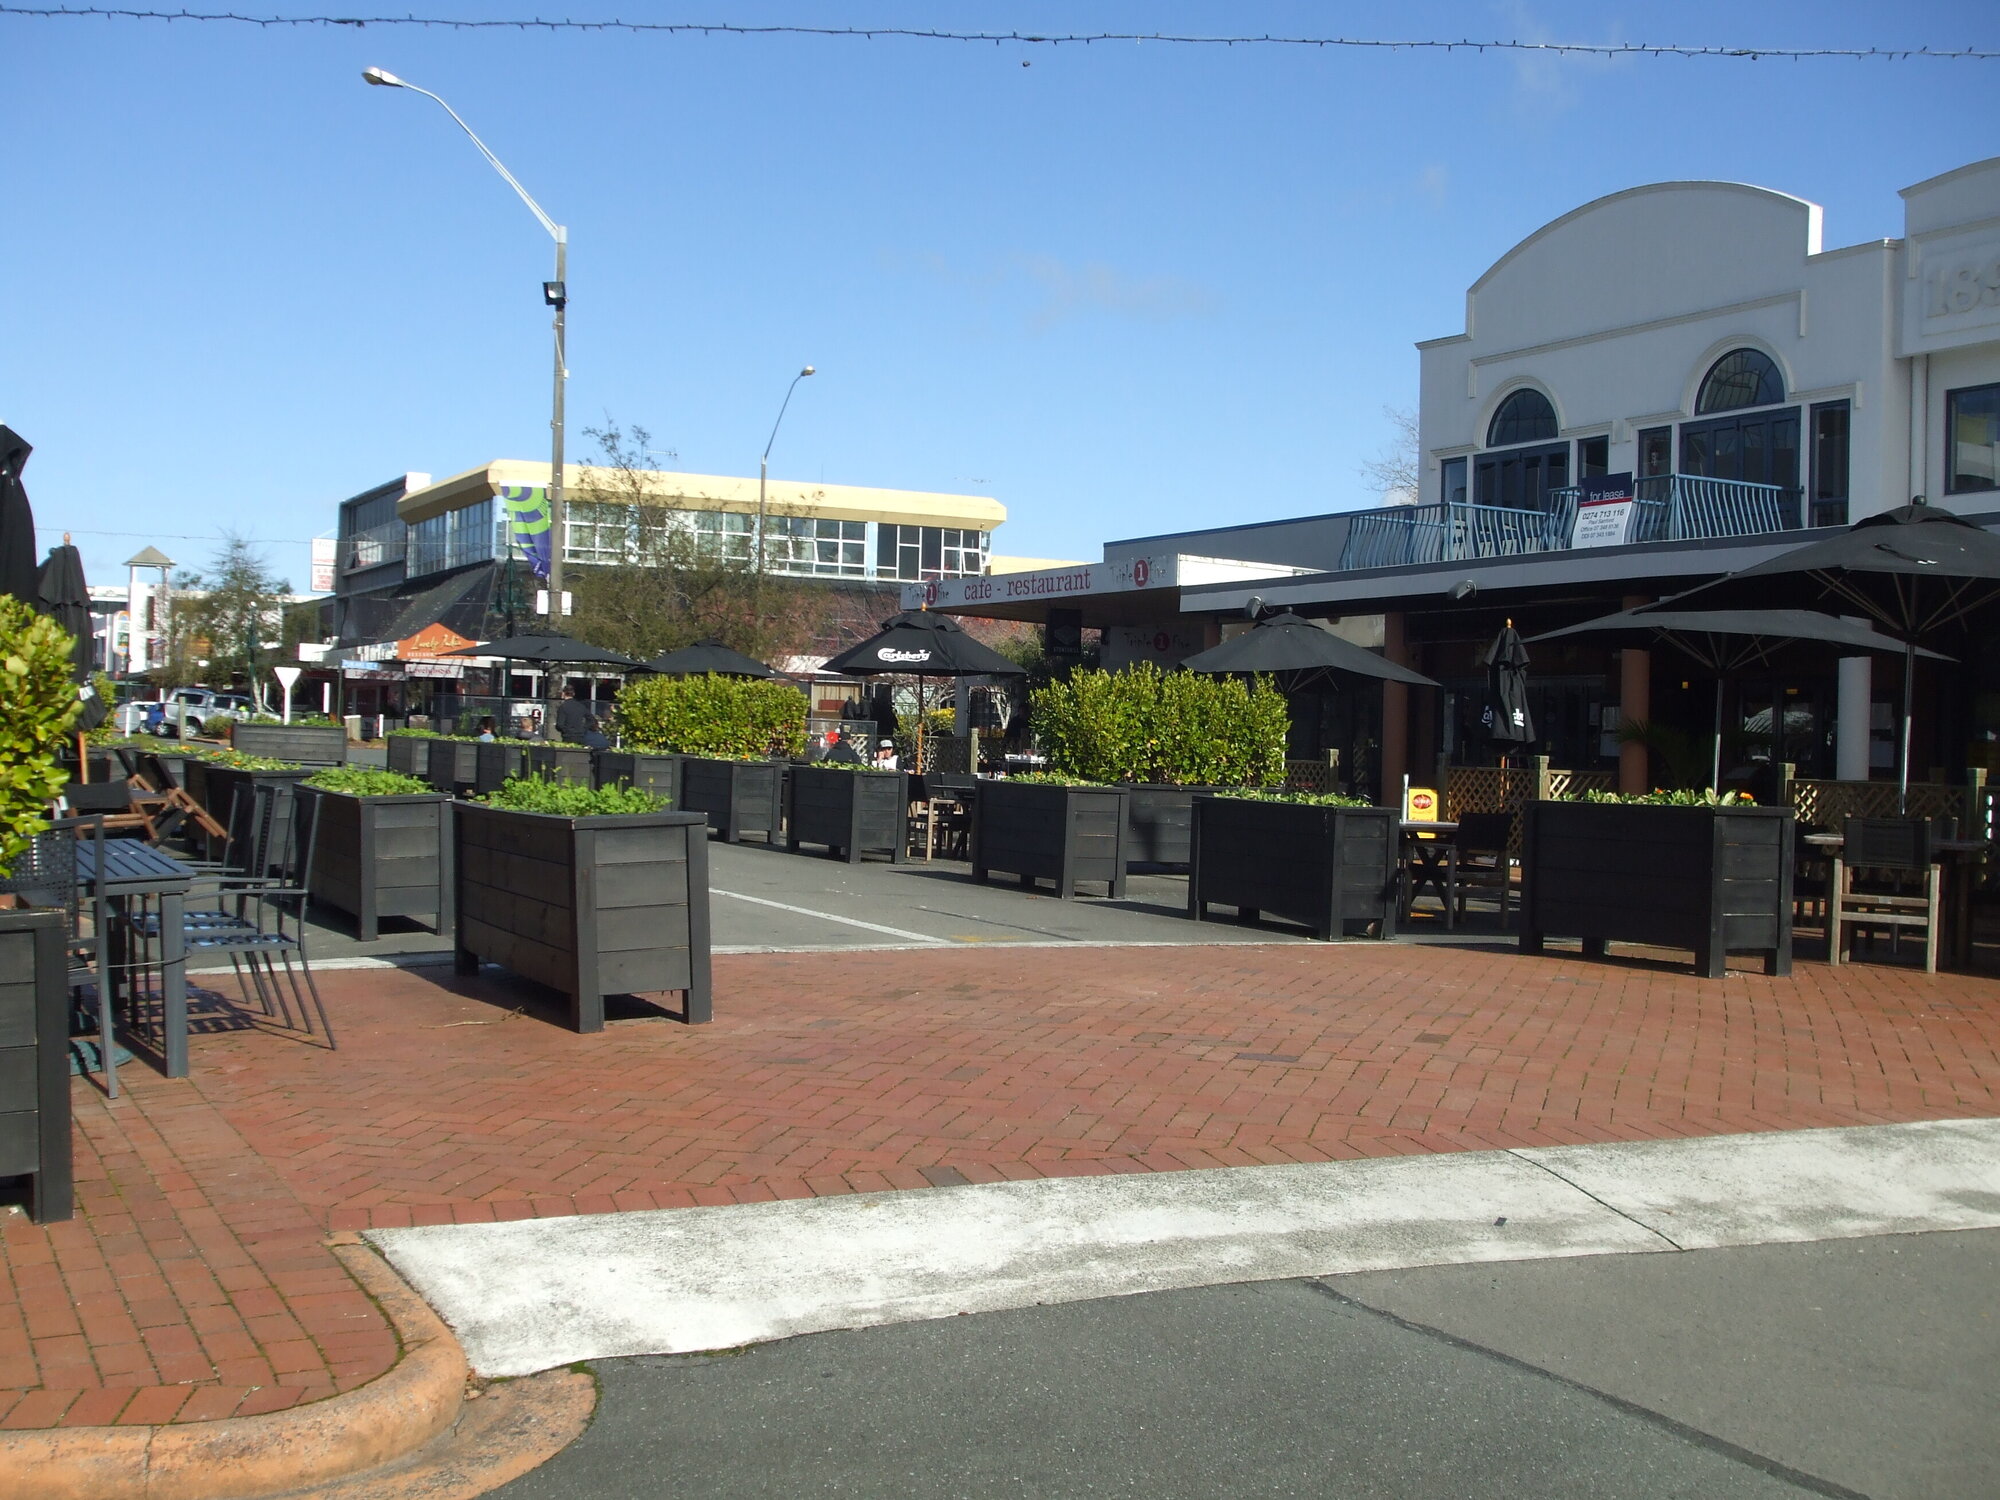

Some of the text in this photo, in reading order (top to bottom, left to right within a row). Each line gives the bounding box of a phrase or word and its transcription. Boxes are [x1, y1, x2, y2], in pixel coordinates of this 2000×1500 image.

[1590, 491, 1624, 502] for lease
[1582, 511, 1598, 520] 0274
[1599, 510, 1611, 518] 713
[964, 579, 992, 600] cafe
[1006, 568, 1091, 596] restaurant
[877, 647, 931, 662] Carlsberg
